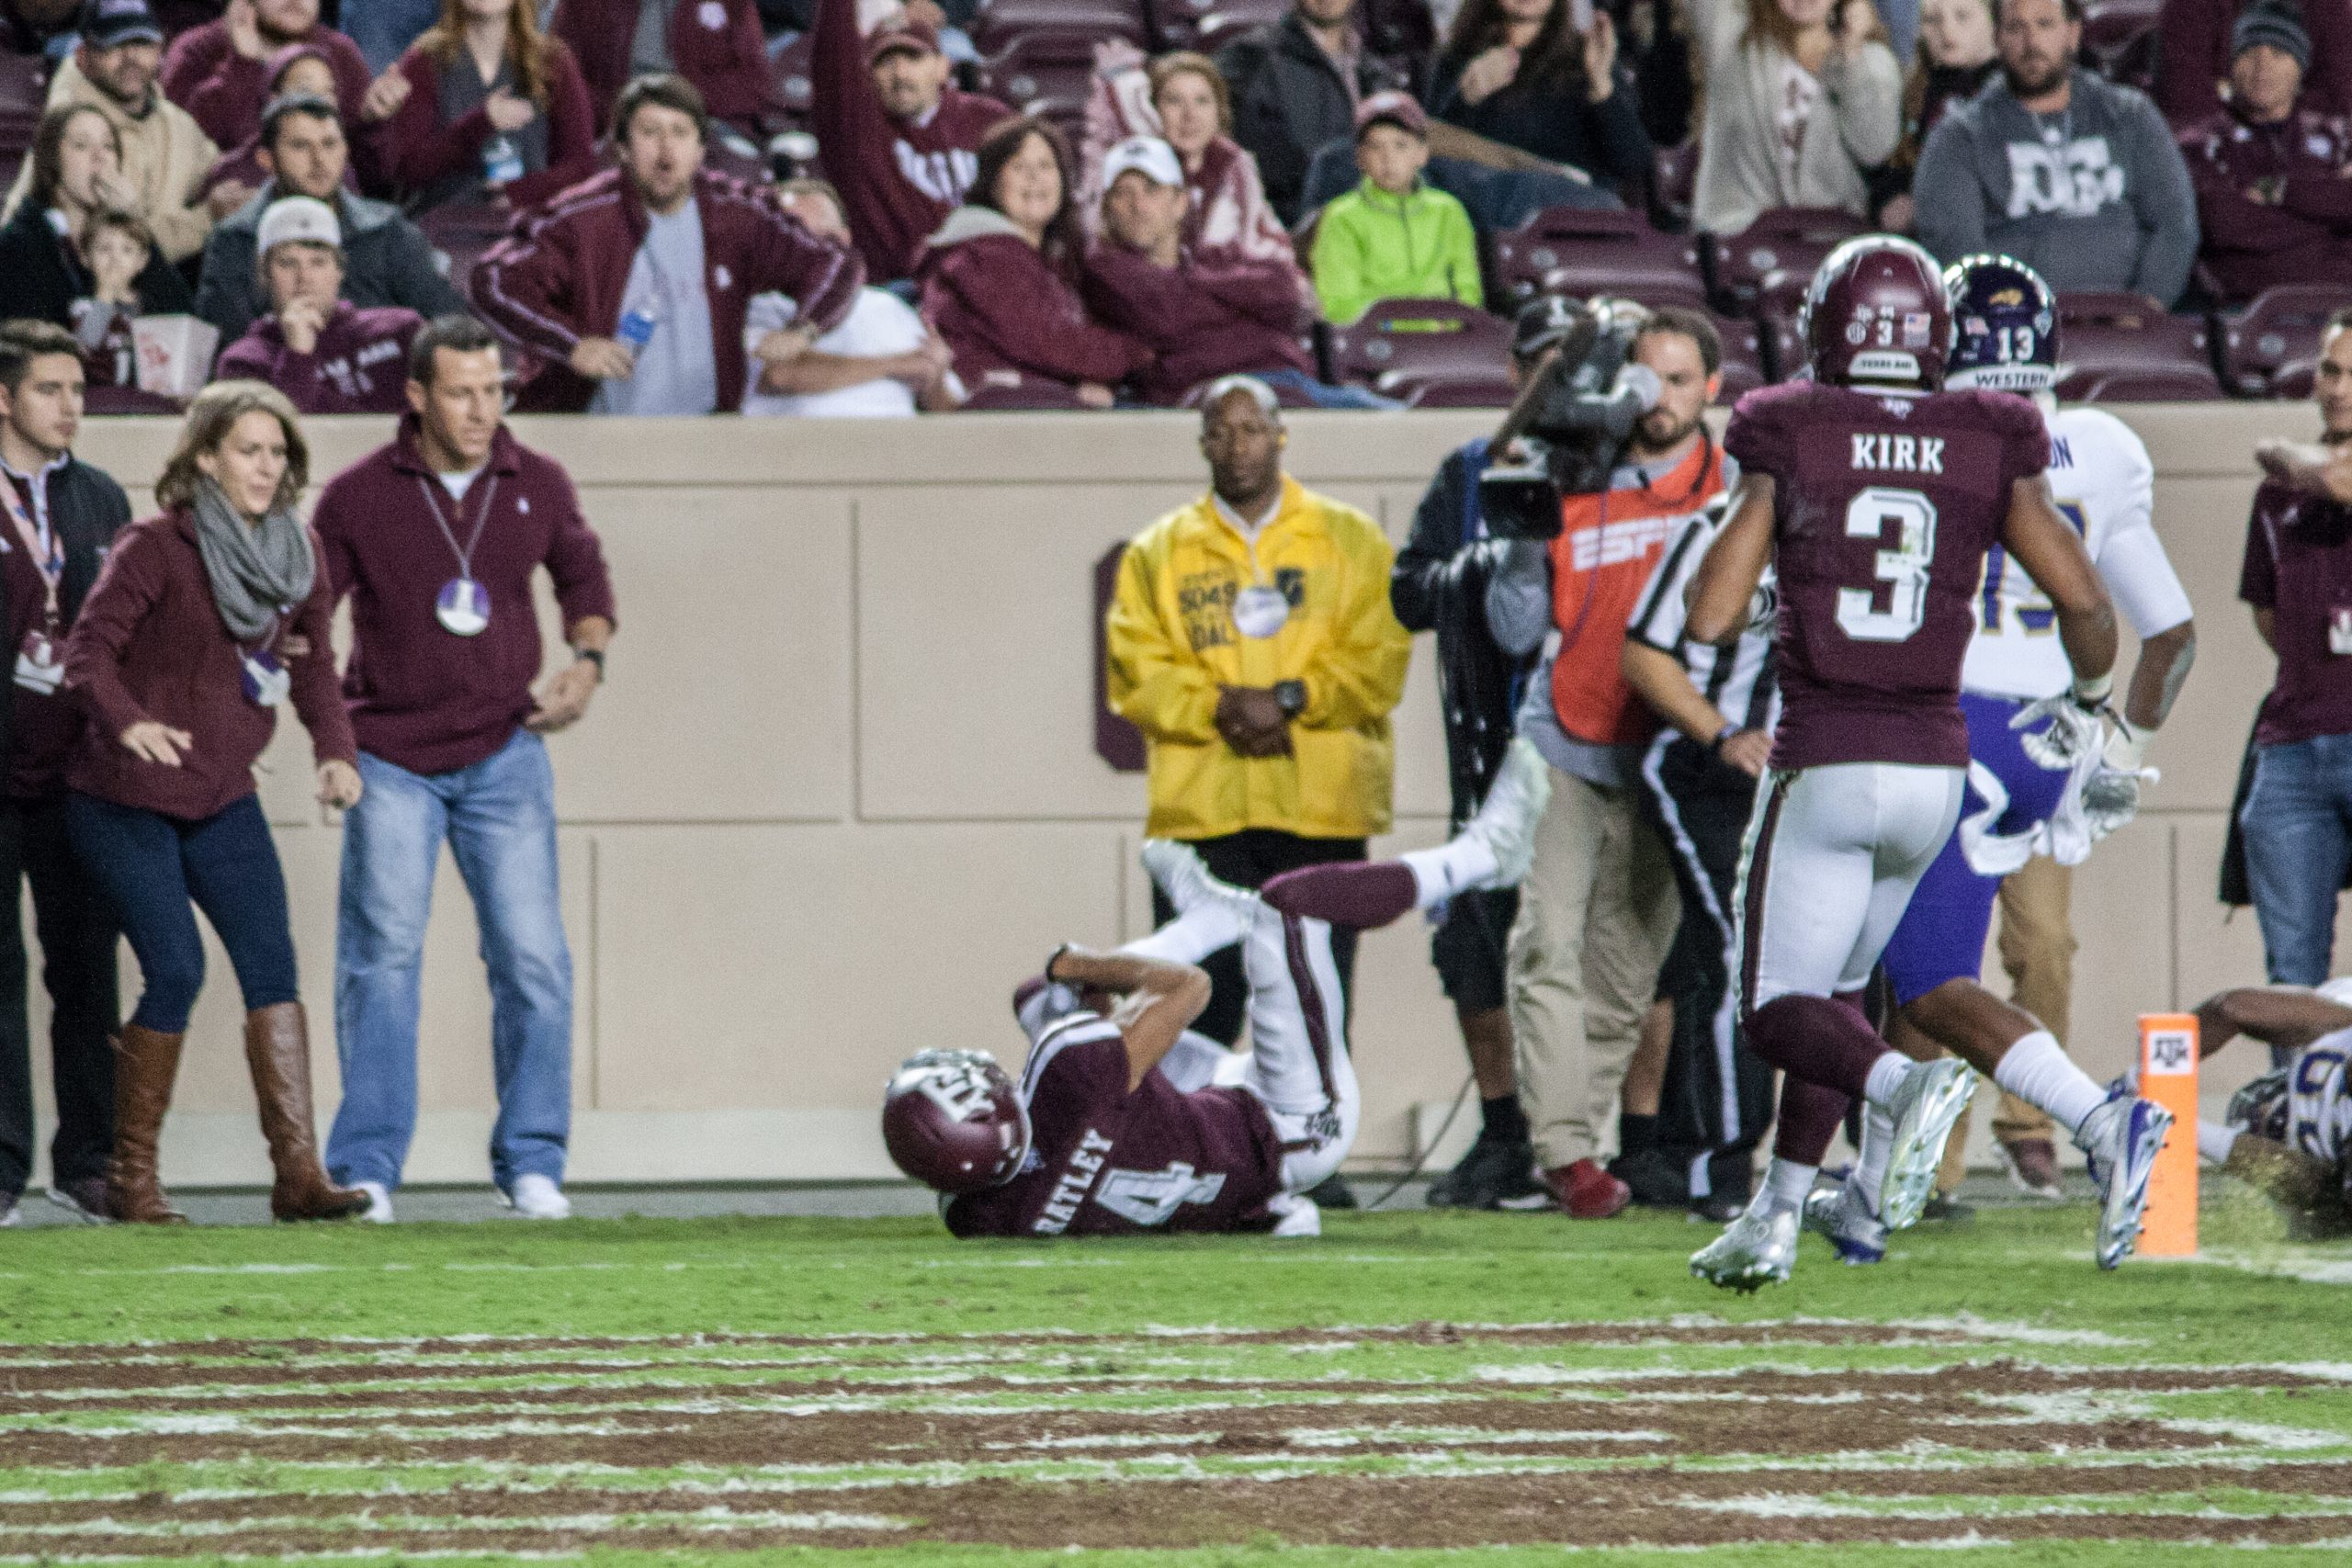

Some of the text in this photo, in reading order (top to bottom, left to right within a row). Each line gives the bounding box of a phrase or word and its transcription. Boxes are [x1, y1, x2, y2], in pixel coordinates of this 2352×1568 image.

[1877, 319, 1894, 347] 3
[1996, 326, 2035, 361] 13
[1975, 373, 2050, 386] WESTERN
[1850, 433, 1945, 474] KIRK
[1834, 485, 1938, 643] 3
[1095, 1160, 1227, 1226] 4
